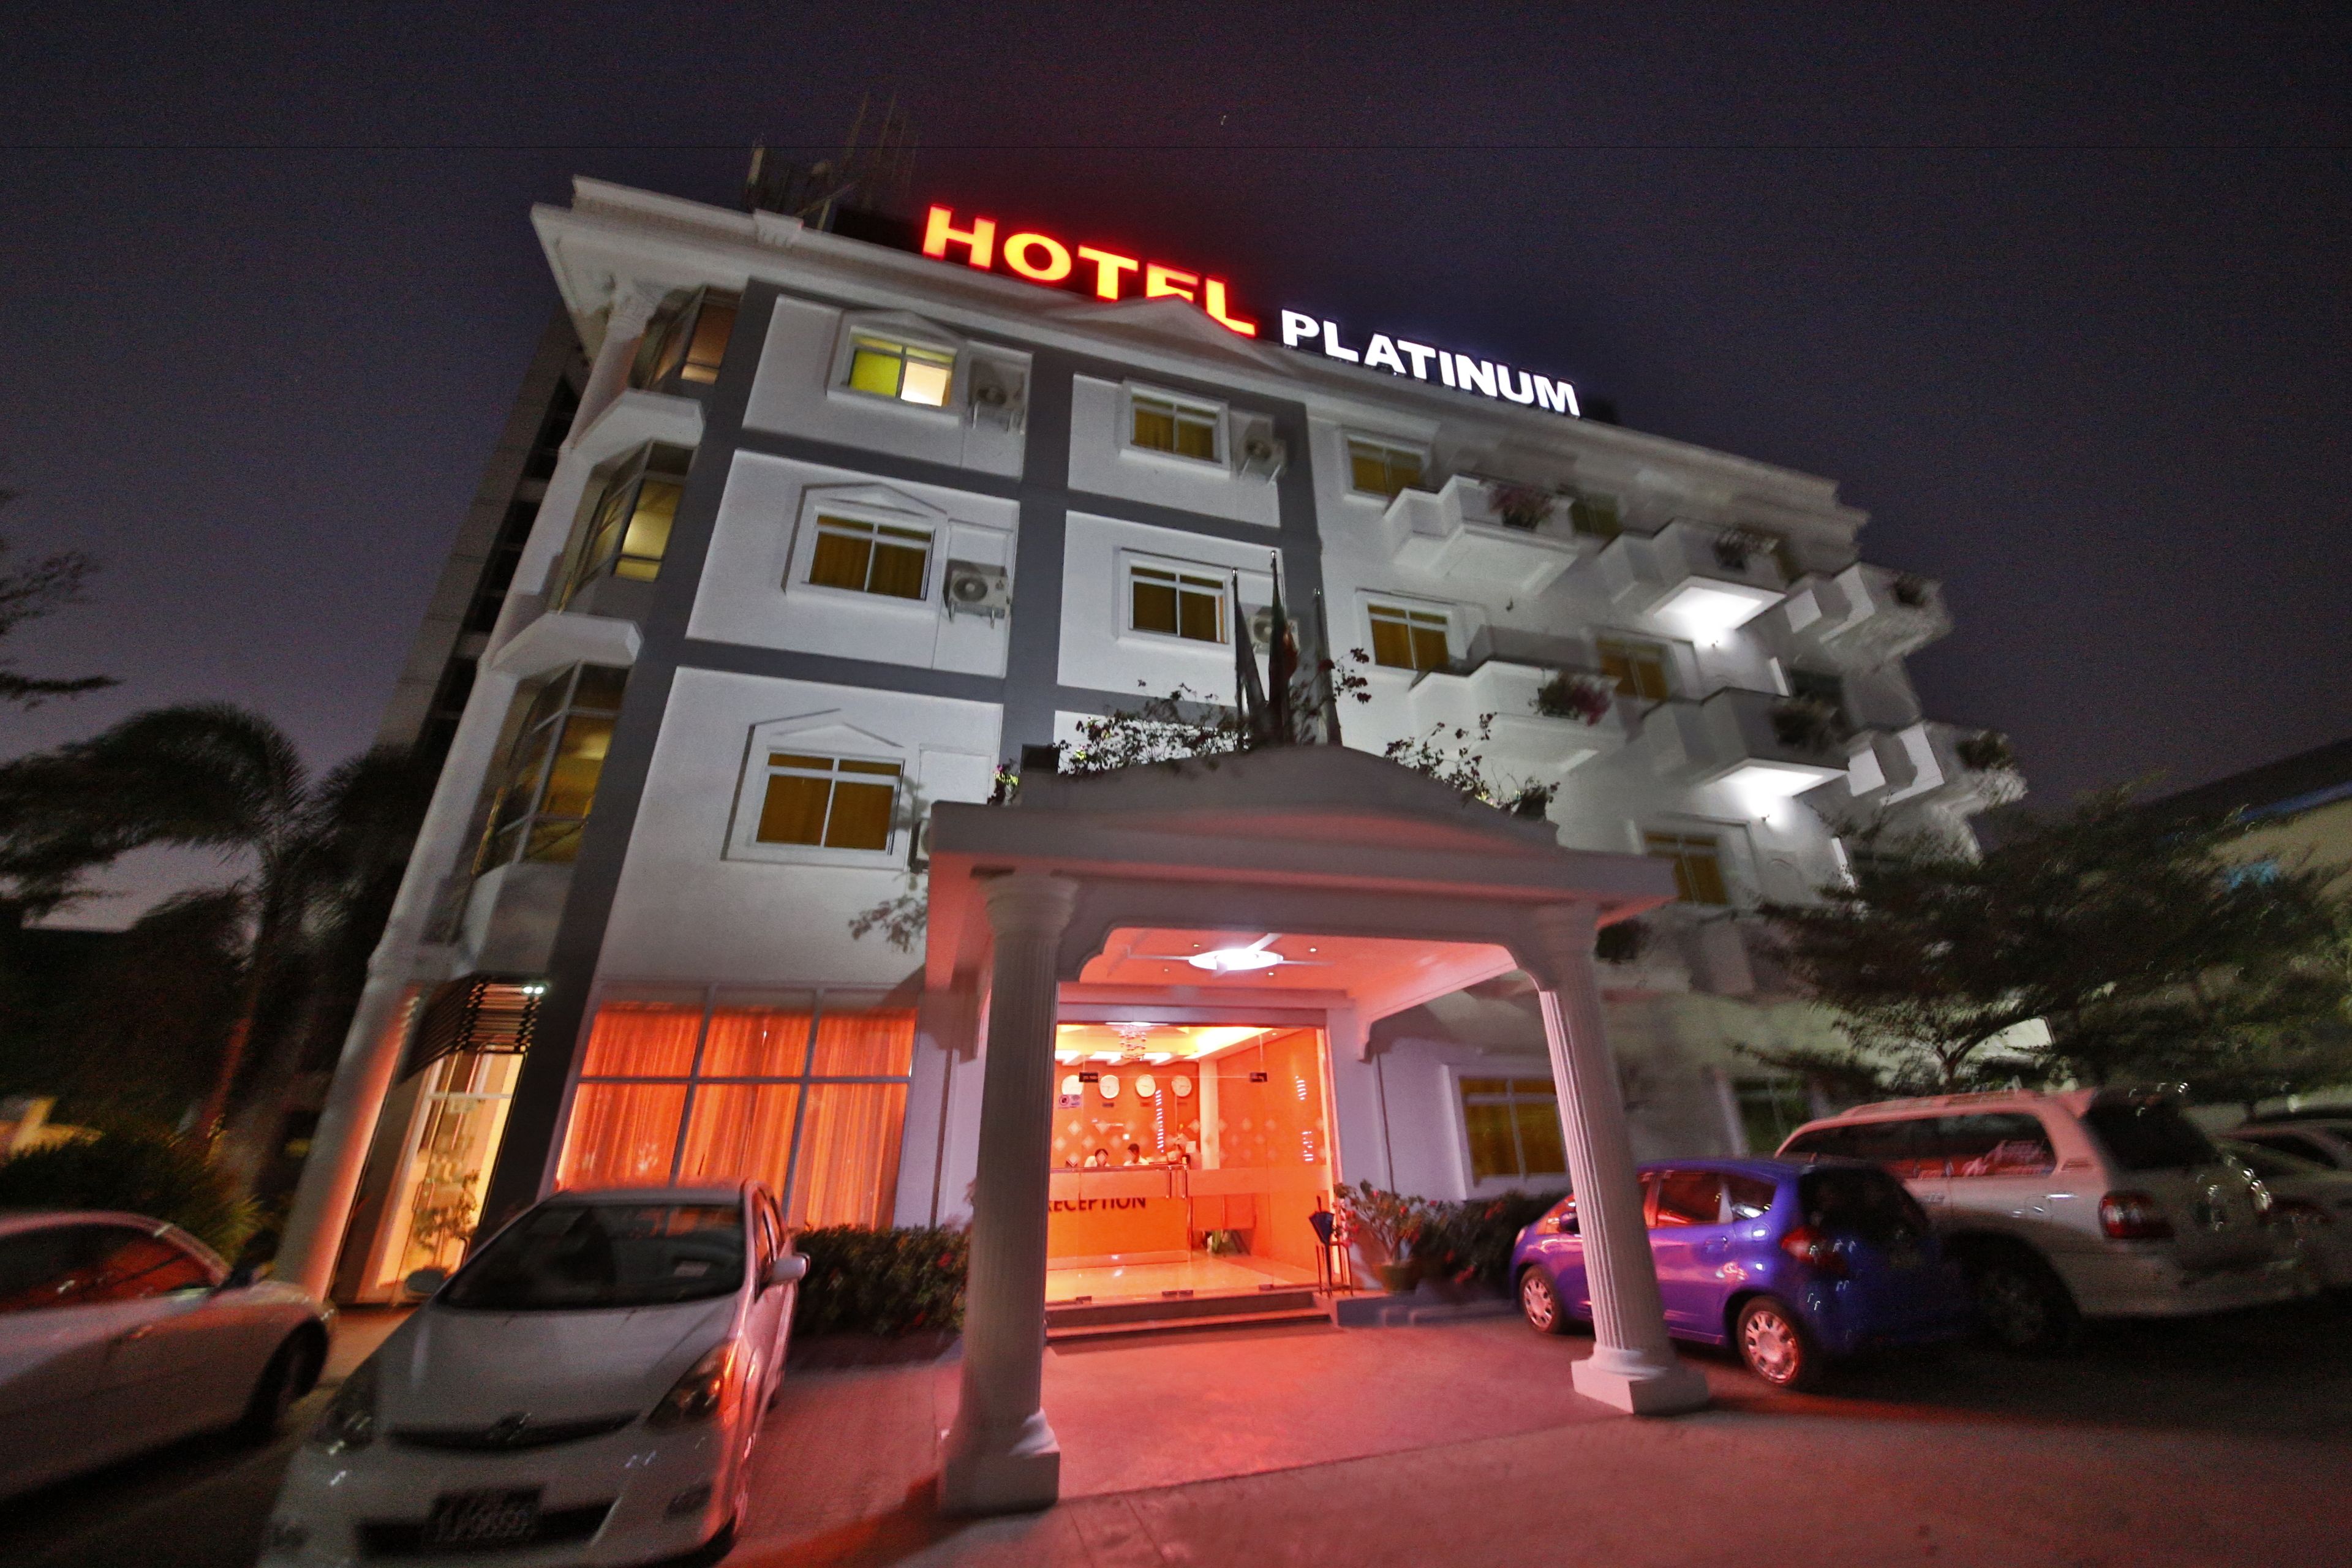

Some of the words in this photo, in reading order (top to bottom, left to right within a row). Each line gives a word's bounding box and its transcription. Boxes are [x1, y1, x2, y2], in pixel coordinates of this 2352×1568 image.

[922, 205, 1256, 337] HOTEL
[1281, 308, 1581, 418] PLATINUM
[1049, 1197, 1146, 1212] ECEPTION
